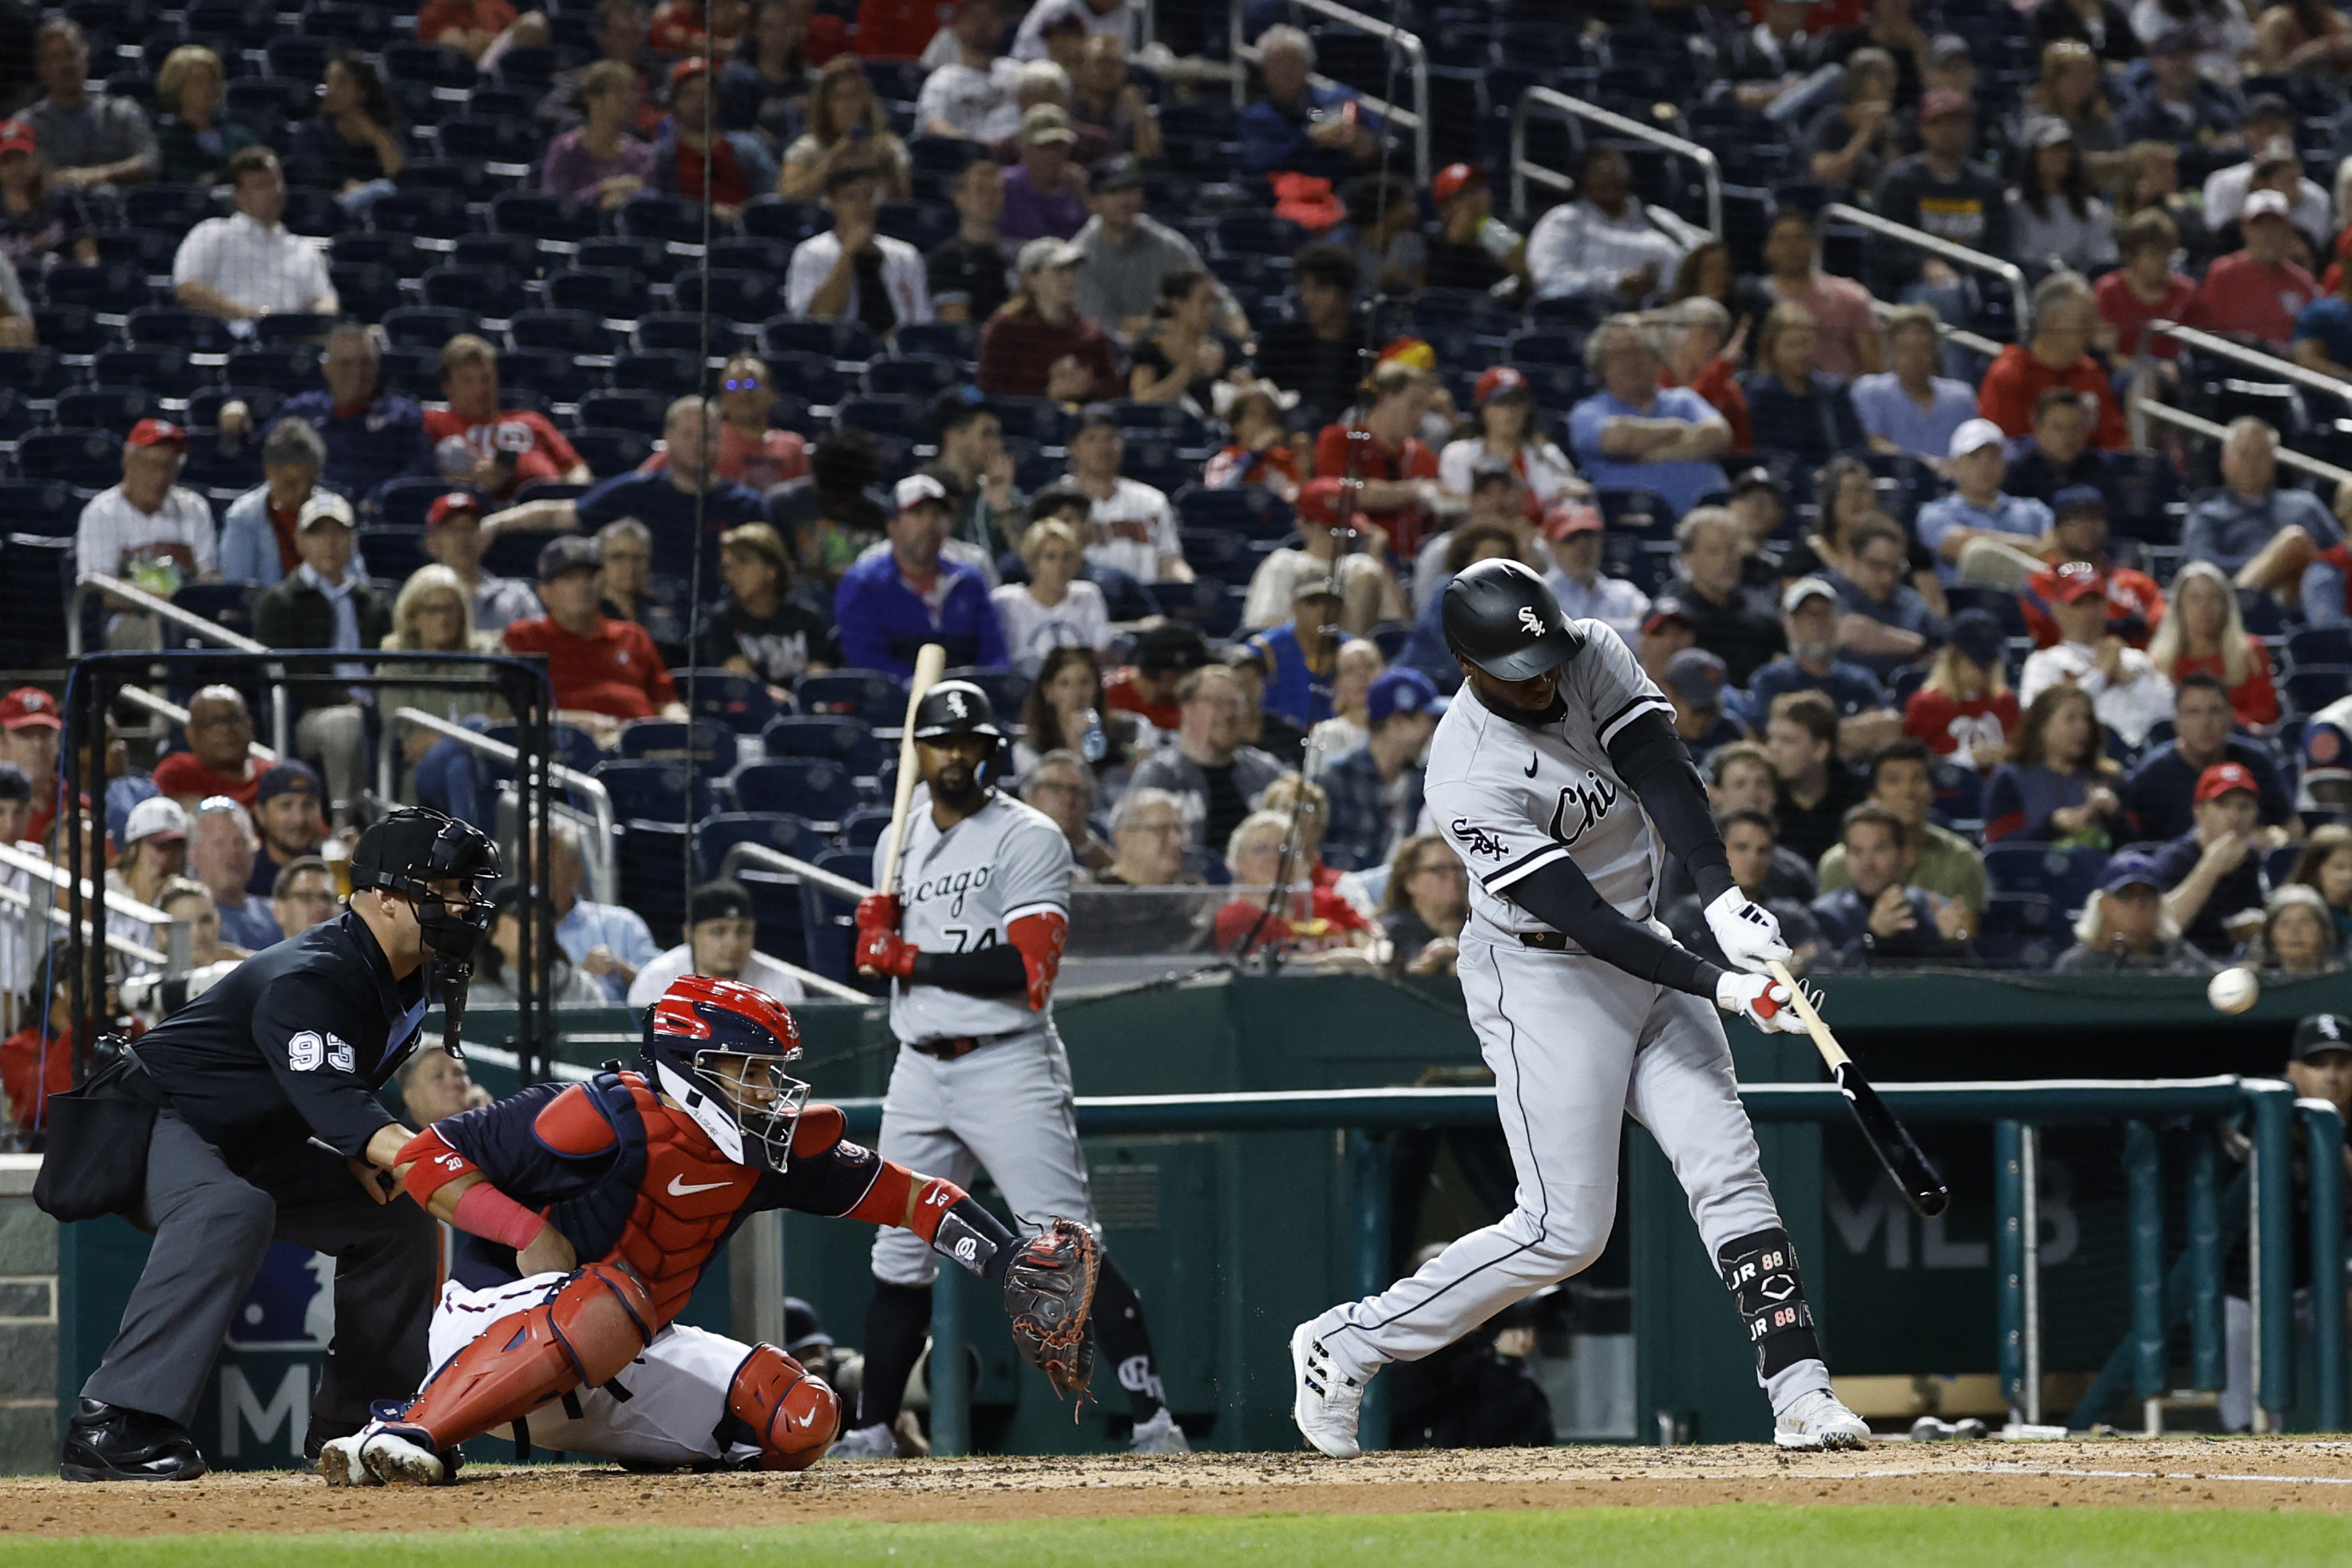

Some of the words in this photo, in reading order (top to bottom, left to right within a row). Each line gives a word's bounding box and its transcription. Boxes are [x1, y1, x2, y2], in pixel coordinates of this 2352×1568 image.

[1548, 769, 1617, 848] Chi
[288, 1030, 356, 1074] 93
[445, 1156, 463, 1171] 20
[1731, 1262, 1756, 1290] JR
[1761, 1250, 1784, 1271] 88
[1750, 1317, 1768, 1341] JR
[1774, 1306, 1796, 1327] 88
